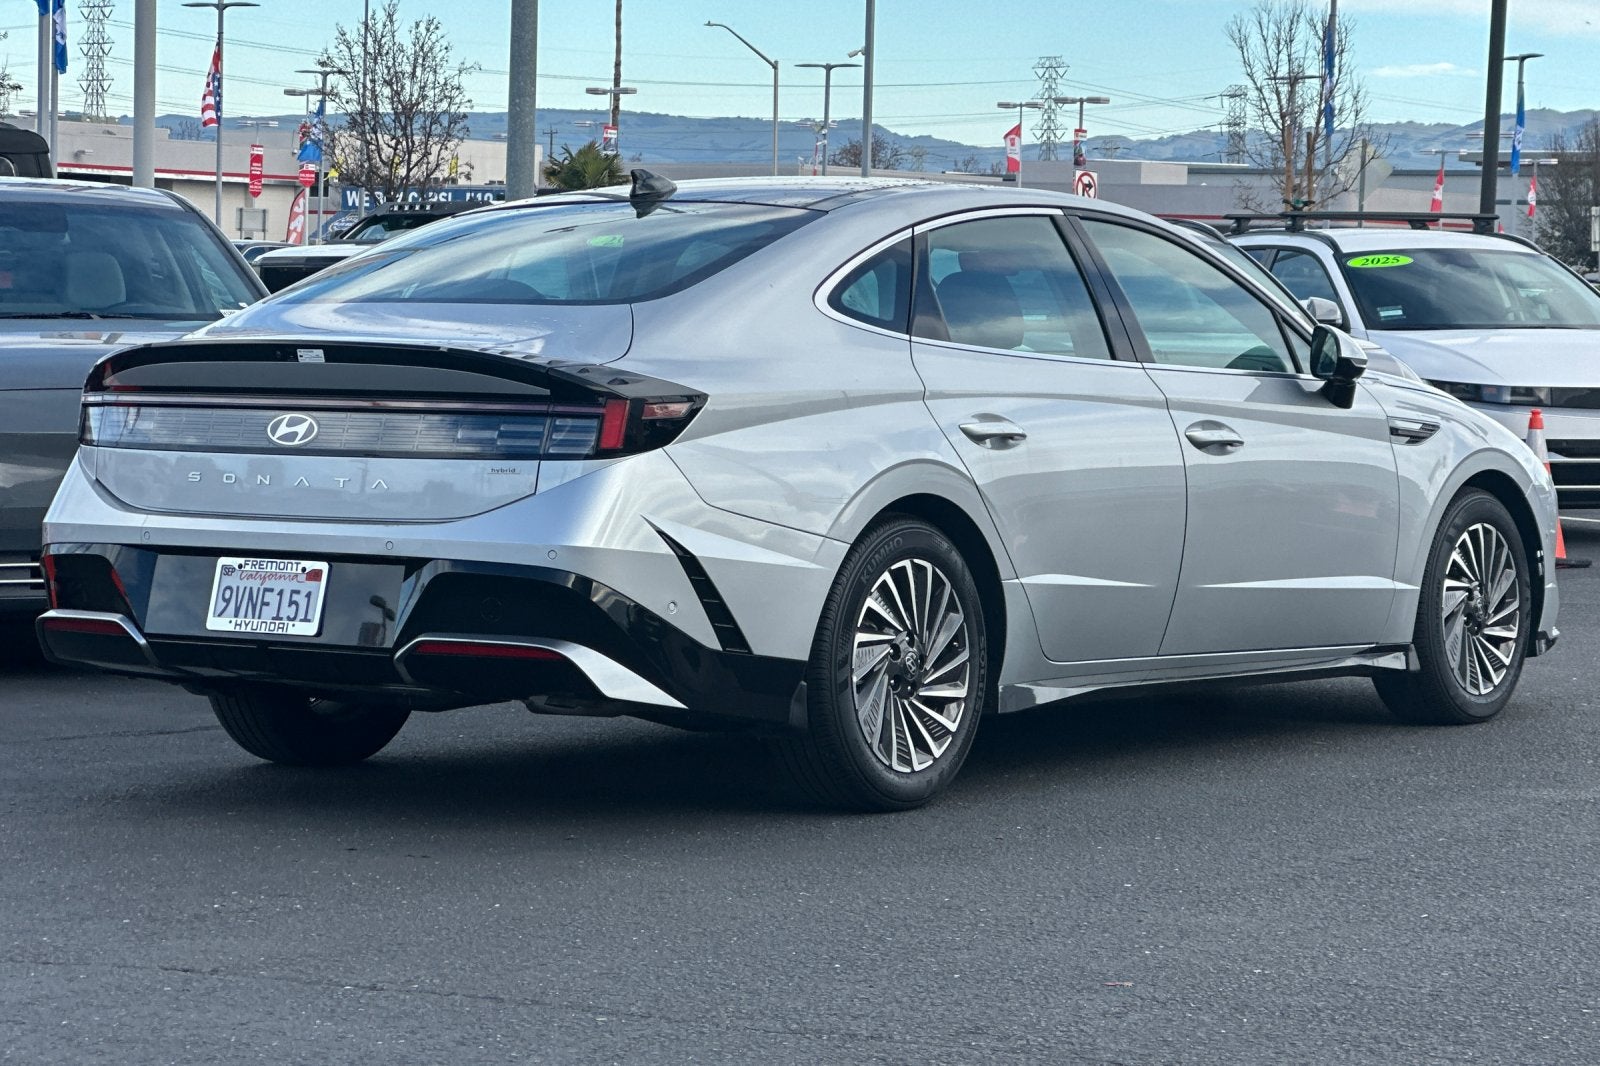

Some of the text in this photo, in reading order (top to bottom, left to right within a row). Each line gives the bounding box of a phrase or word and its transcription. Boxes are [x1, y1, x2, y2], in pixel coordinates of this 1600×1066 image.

[346, 190, 370, 206] WE
[1361, 256, 1401, 266] 2025
[188, 471, 388, 490] SONATA
[243, 559, 302, 573] FREMONT
[860, 536, 904, 585] KUMHO
[223, 565, 236, 577] SEP
[240, 570, 305, 586] California
[217, 585, 312, 623] 9VNF151
[234, 620, 290, 633] HYUNDAI
